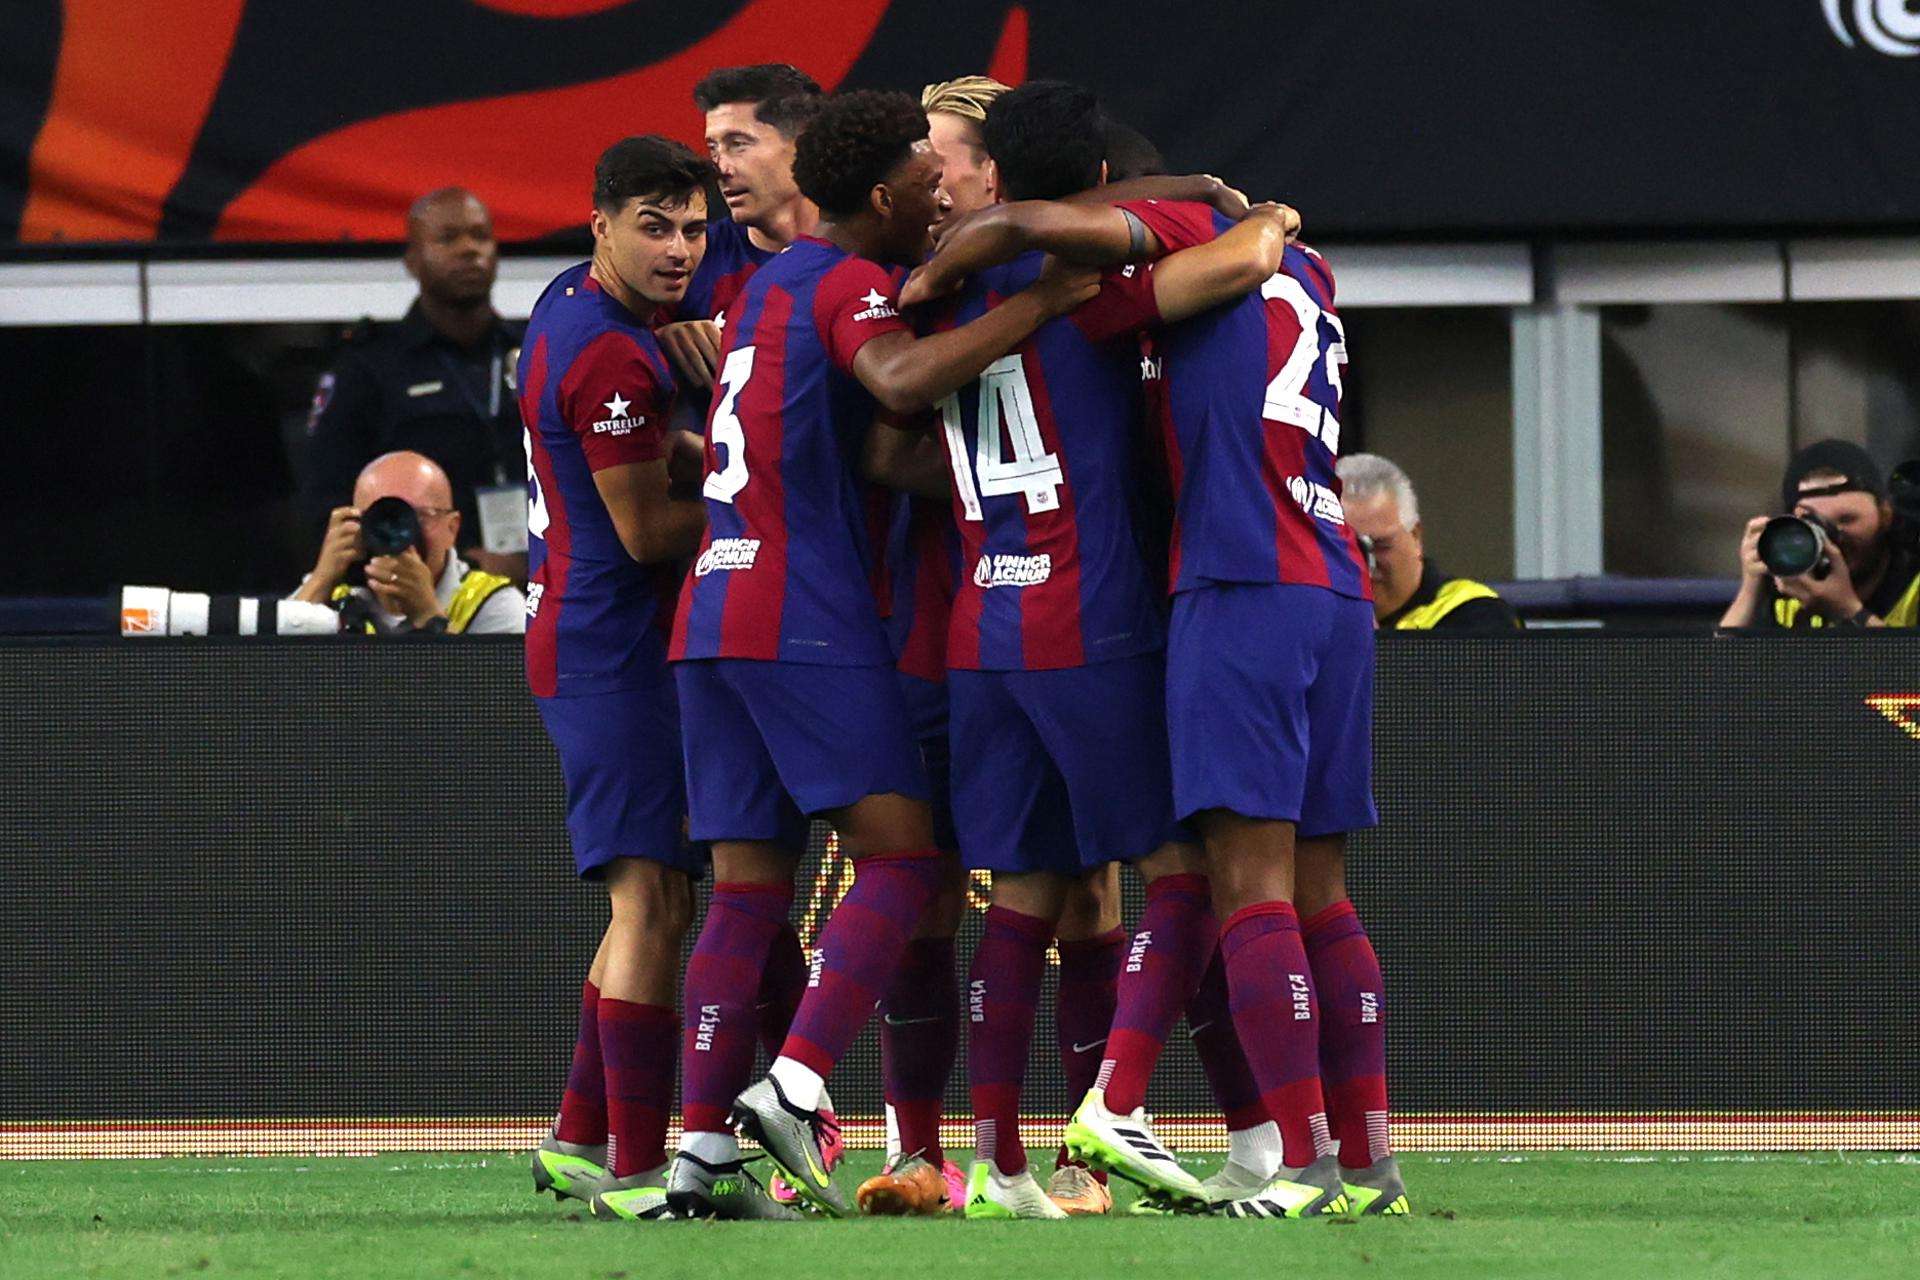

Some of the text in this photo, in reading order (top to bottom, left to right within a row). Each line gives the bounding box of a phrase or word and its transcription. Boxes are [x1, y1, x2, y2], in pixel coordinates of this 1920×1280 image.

[592, 416, 645, 433] ESTRELLA
[703, 346, 756, 504] 3
[932, 353, 1064, 521] 14
[992, 565, 1051, 581] ACNUR
[993, 553, 1051, 570] UNHCR
[1126, 931, 1152, 973] BARÇA
[969, 979, 987, 1022] BARÇA
[1288, 973, 1310, 1021] BARÇA
[695, 1004, 720, 1051] BARÇA
